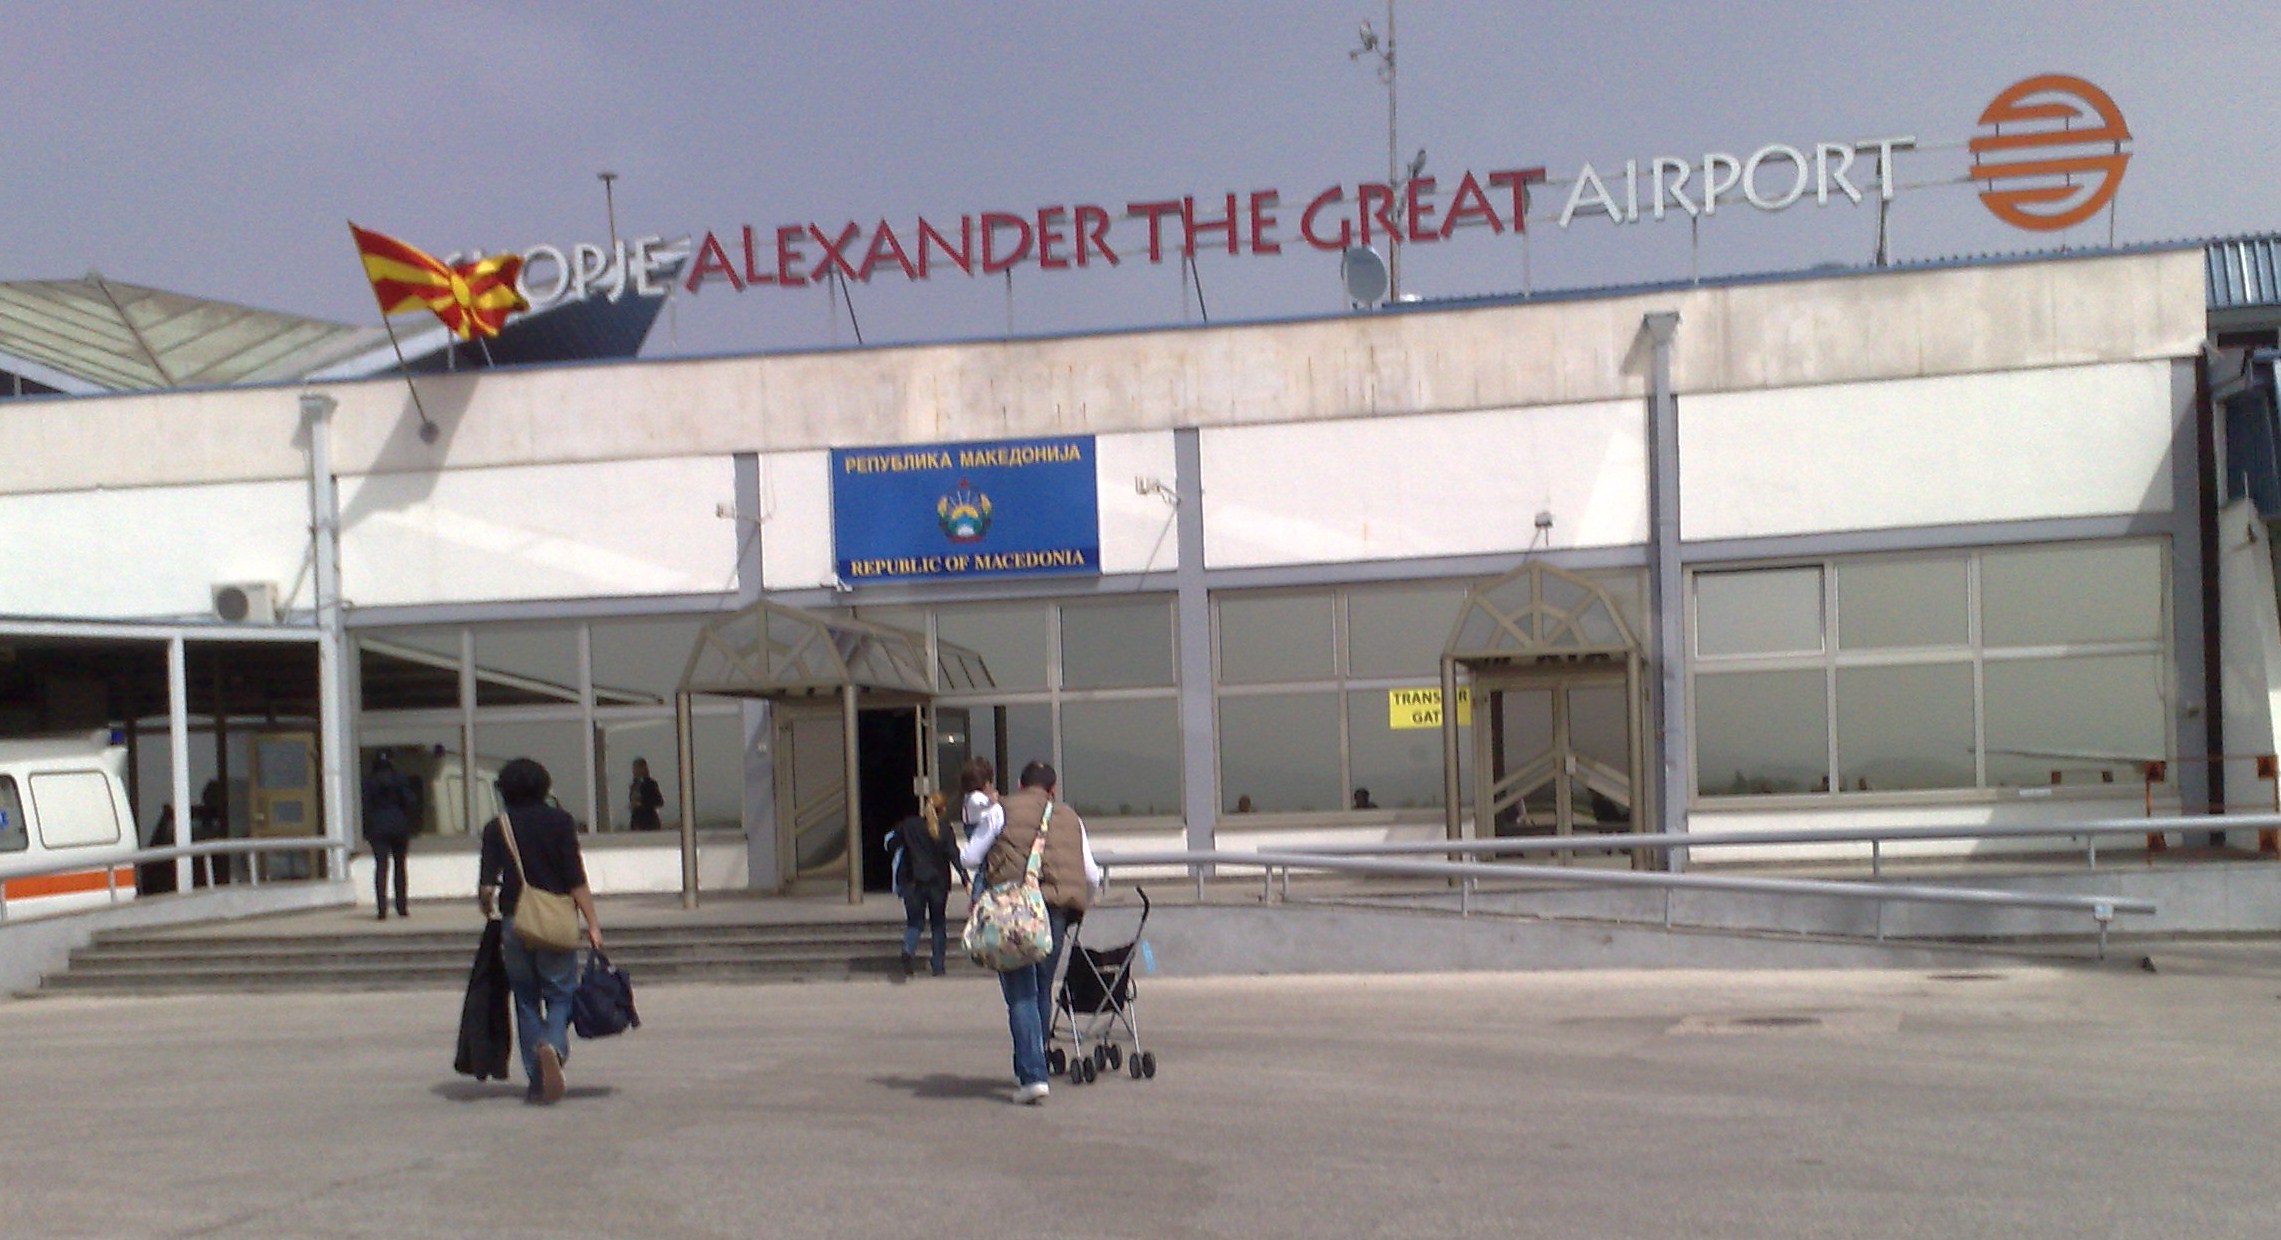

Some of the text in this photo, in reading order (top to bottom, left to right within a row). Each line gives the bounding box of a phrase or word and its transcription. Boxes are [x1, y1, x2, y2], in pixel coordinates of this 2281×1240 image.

[444, 135, 1916, 303] OPJE ALEXANDER THE GREAT AIRPORT
[844, 443, 1081, 473] РЕПУБЛИКА МАКЕДОНИЈА
[851, 549, 1084, 578] REPUBLIC OF MACEDONIA
[1394, 689, 1467, 705] TRANSR
[1412, 711, 1443, 724] GAT
